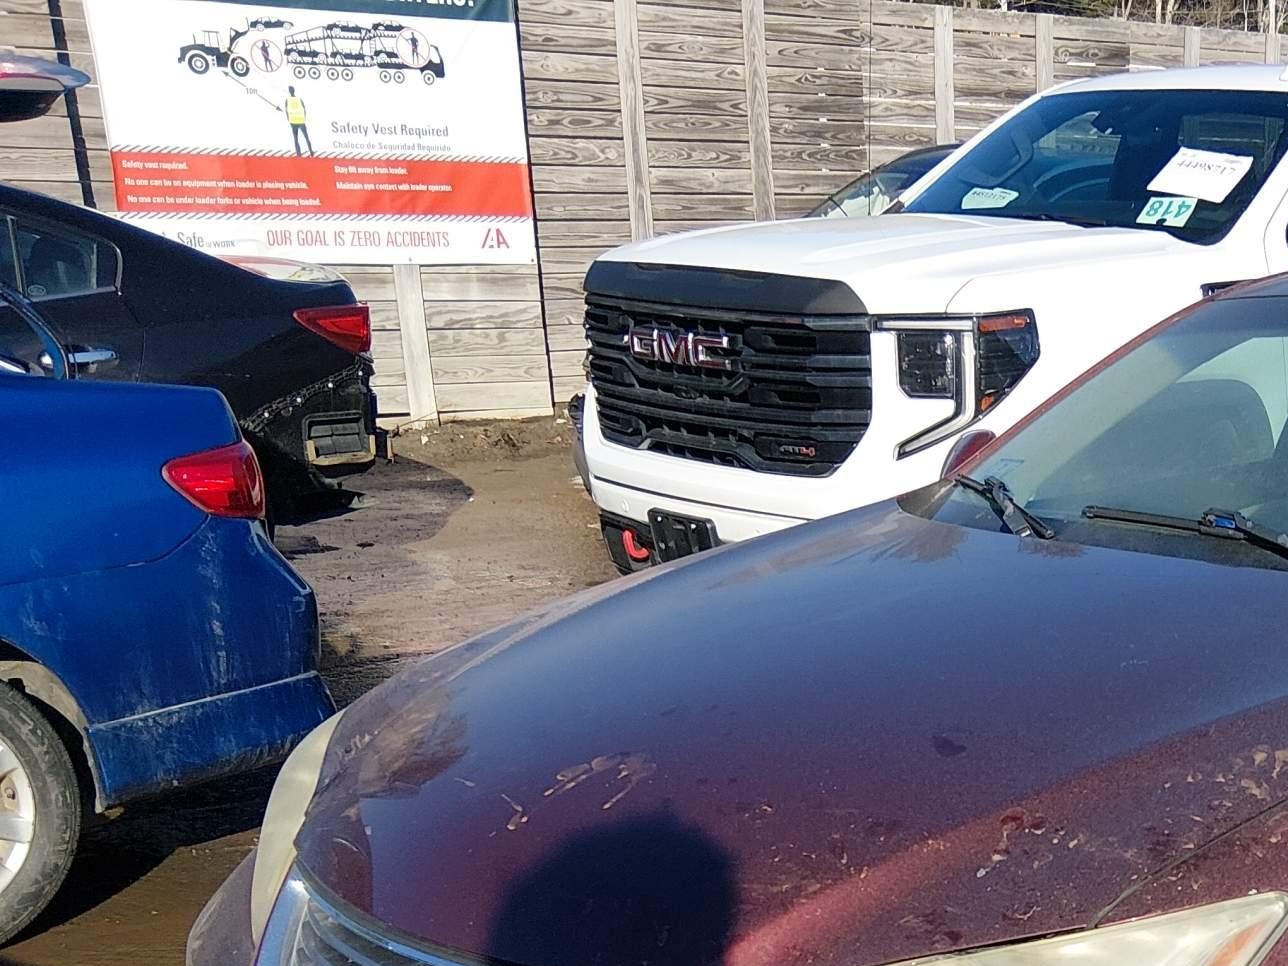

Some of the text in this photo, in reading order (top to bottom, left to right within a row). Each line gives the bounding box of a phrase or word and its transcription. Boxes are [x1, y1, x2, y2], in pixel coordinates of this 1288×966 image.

[331, 121, 448, 140] Safety Vest Required
[1145, 200, 1192, 218] 418
[266, 230, 450, 248] OUR GOAL IS ZERO ACCIDENTS
[623, 327, 733, 371] GMC
